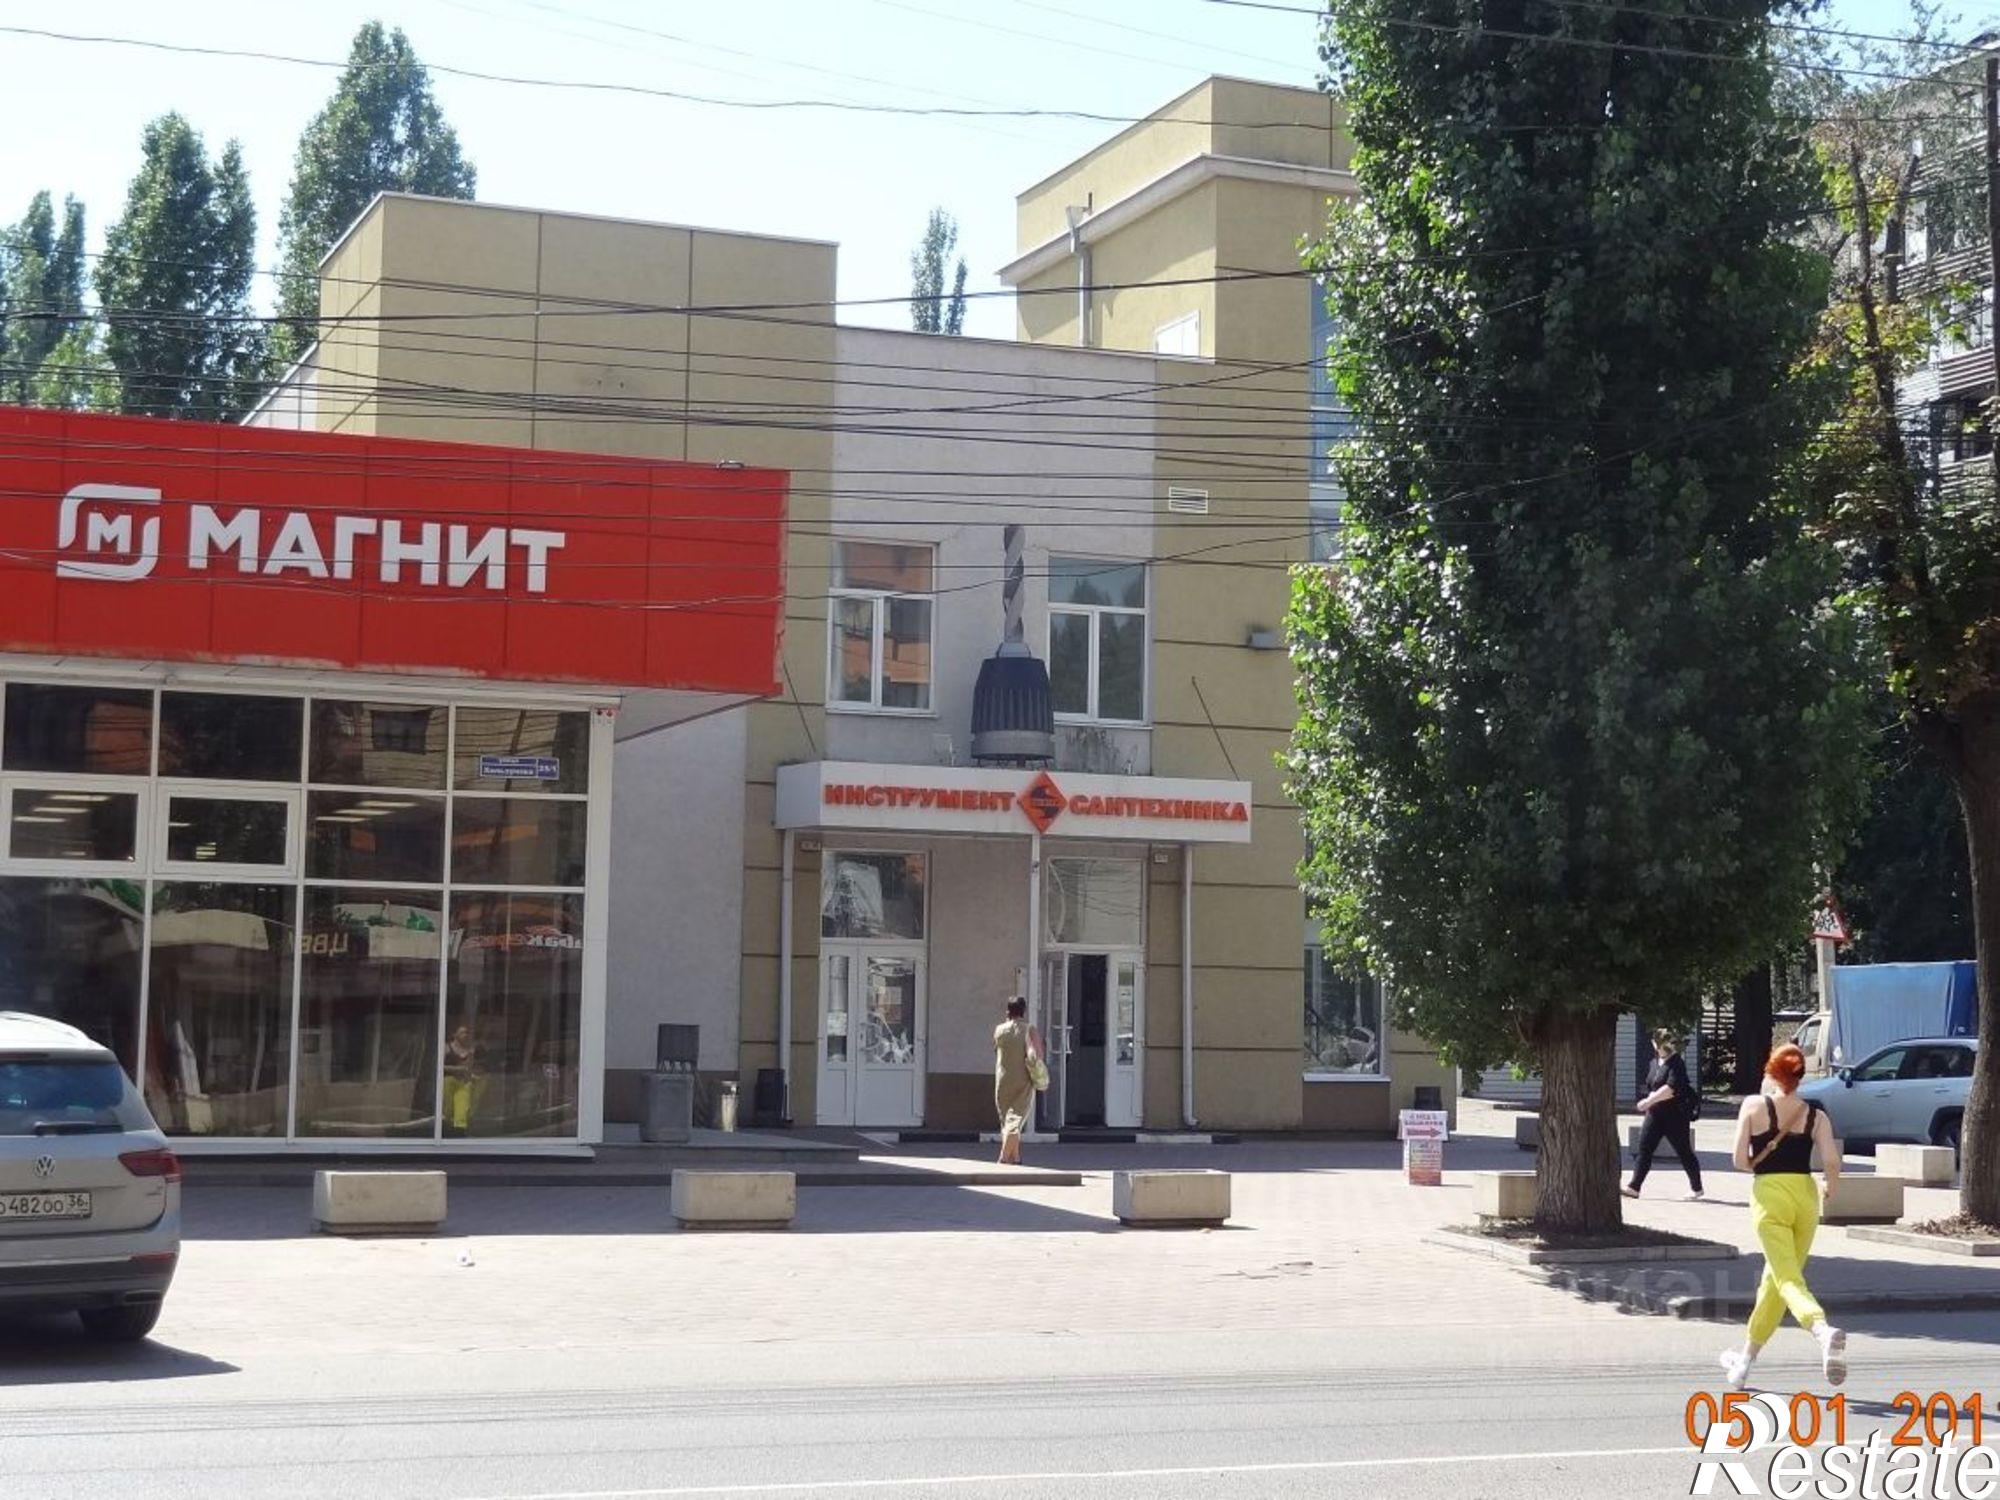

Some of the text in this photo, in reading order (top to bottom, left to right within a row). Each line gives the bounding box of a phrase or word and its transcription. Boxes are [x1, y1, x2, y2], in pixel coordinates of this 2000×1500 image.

[187, 504, 566, 593] МАГНИТ
[824, 784, 1249, 823] ИНСТРУМЕНТ САНТЕХНИКА
